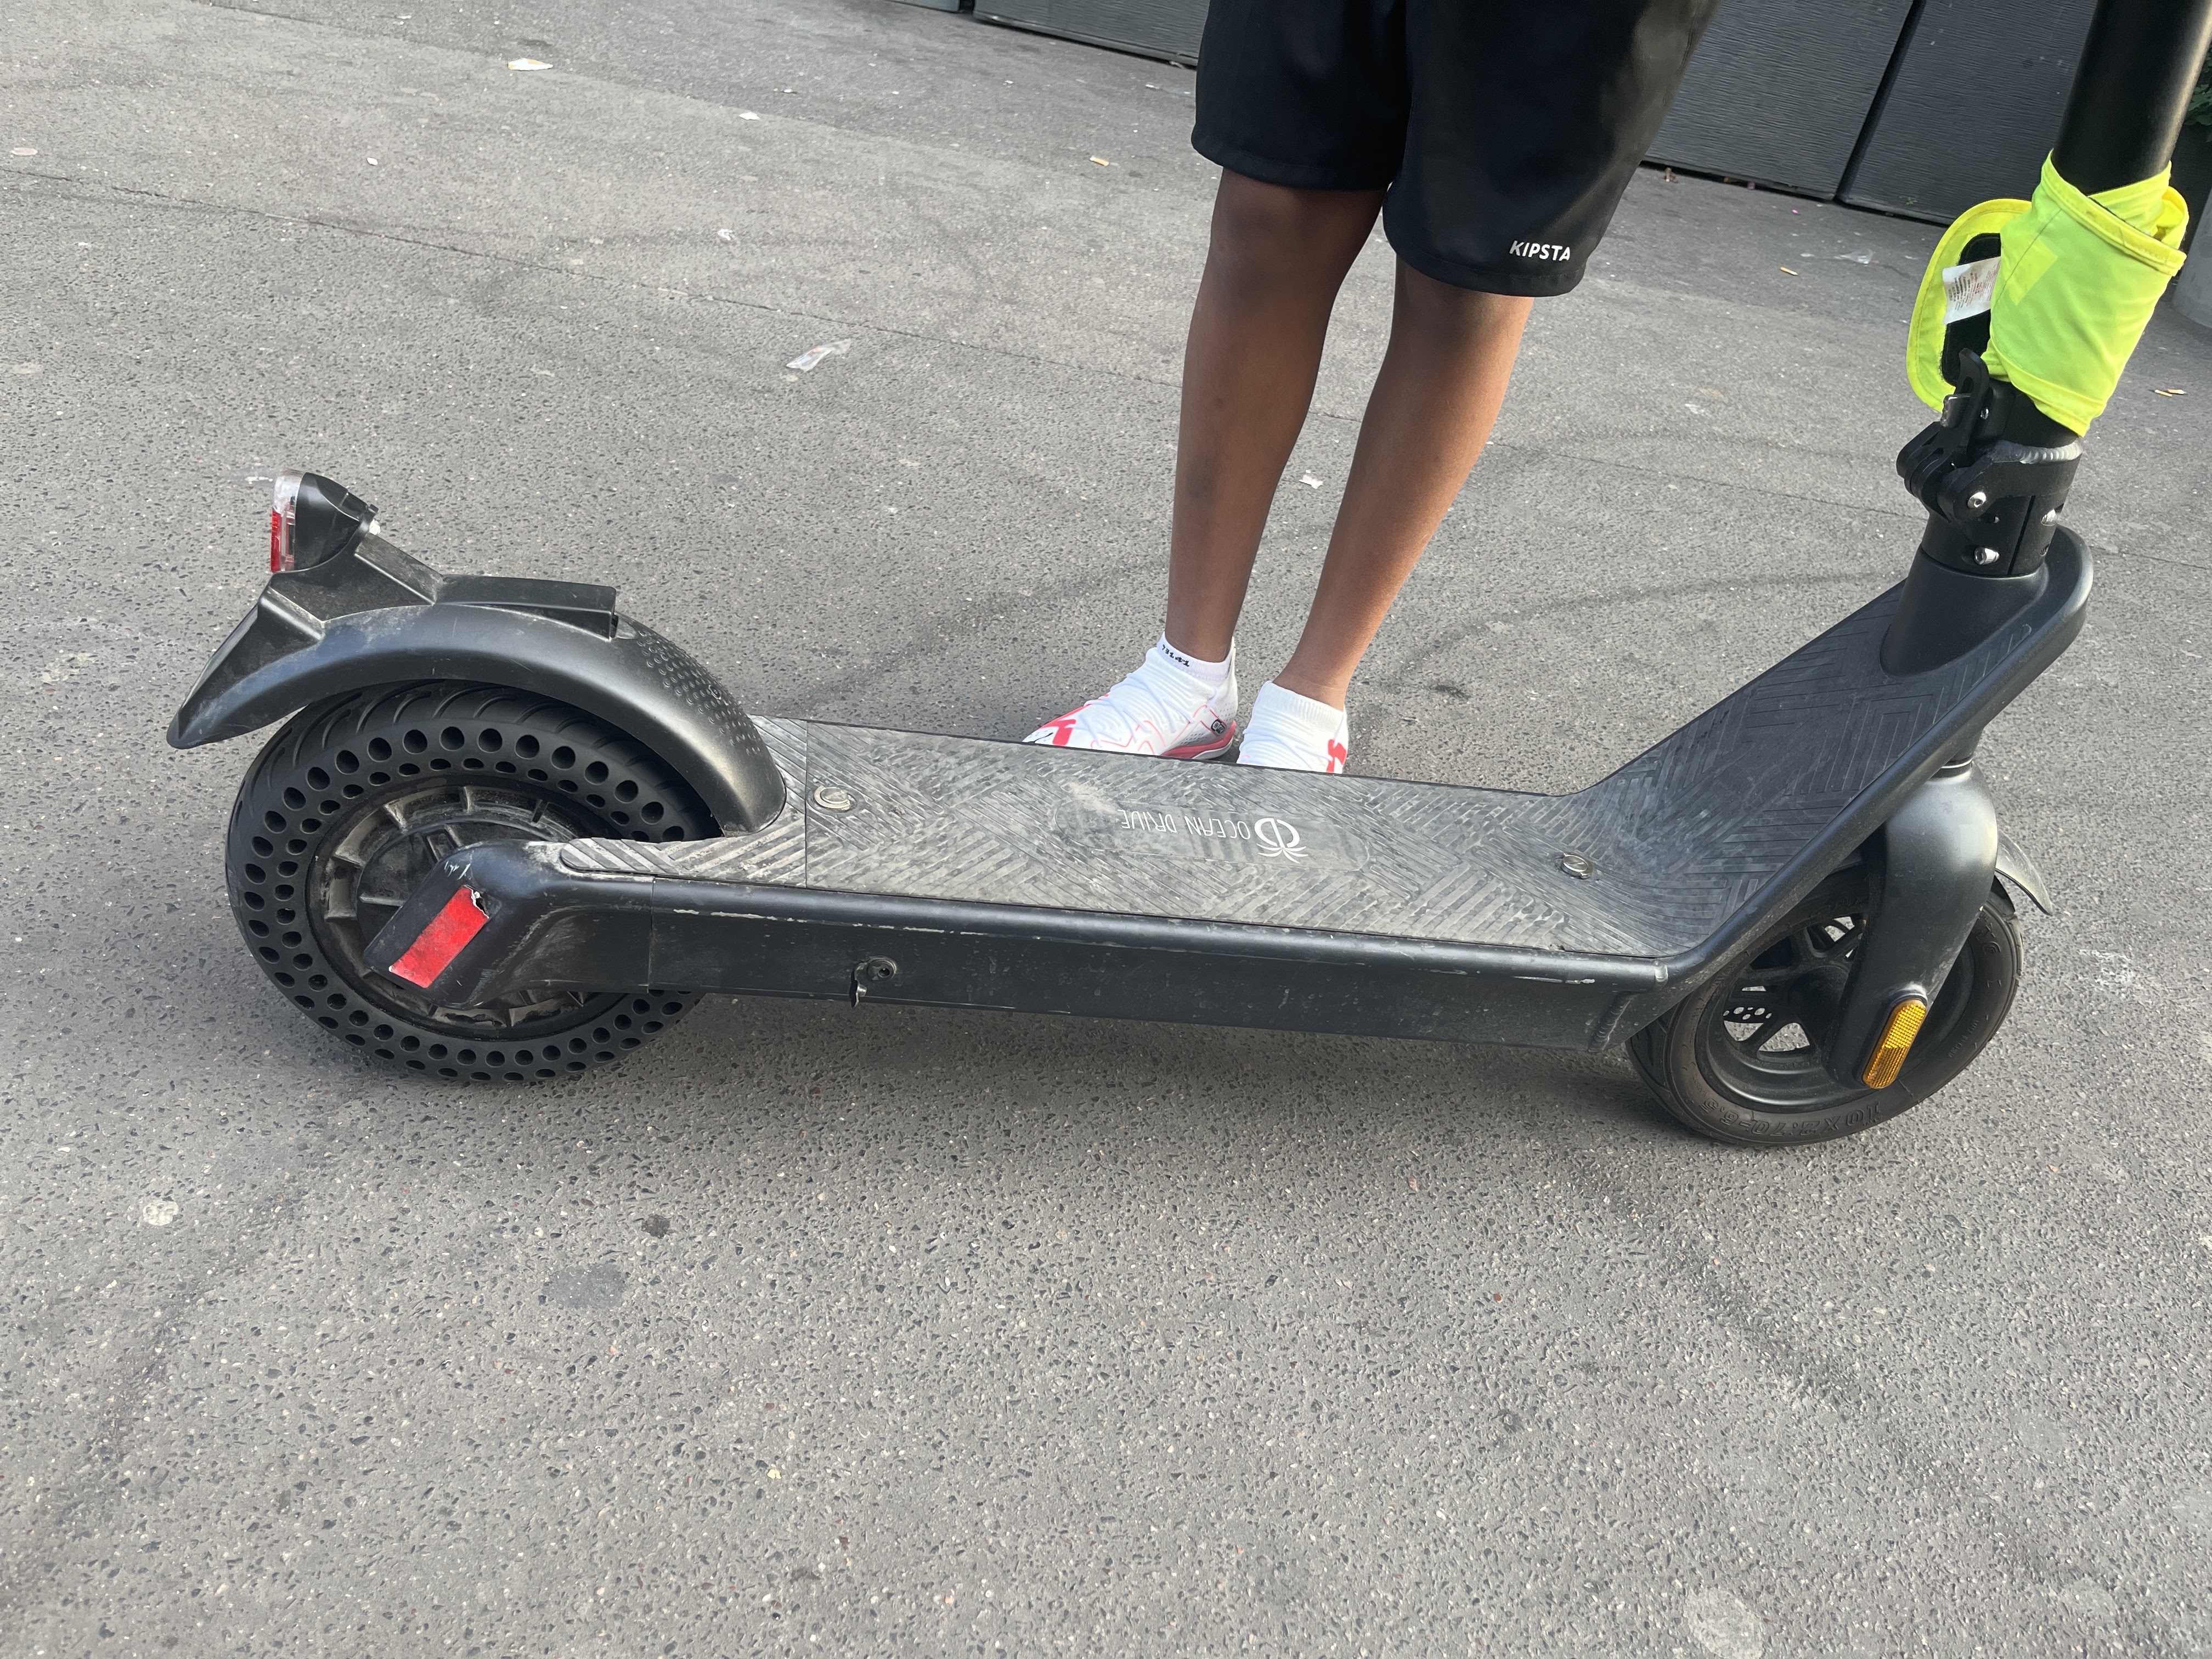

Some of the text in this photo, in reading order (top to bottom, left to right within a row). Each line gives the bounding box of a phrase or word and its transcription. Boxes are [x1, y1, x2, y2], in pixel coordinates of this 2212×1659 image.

[1509, 240, 1571, 261] KIPSTA
[1118, 809, 1251, 840] OCEAN DRIVE
